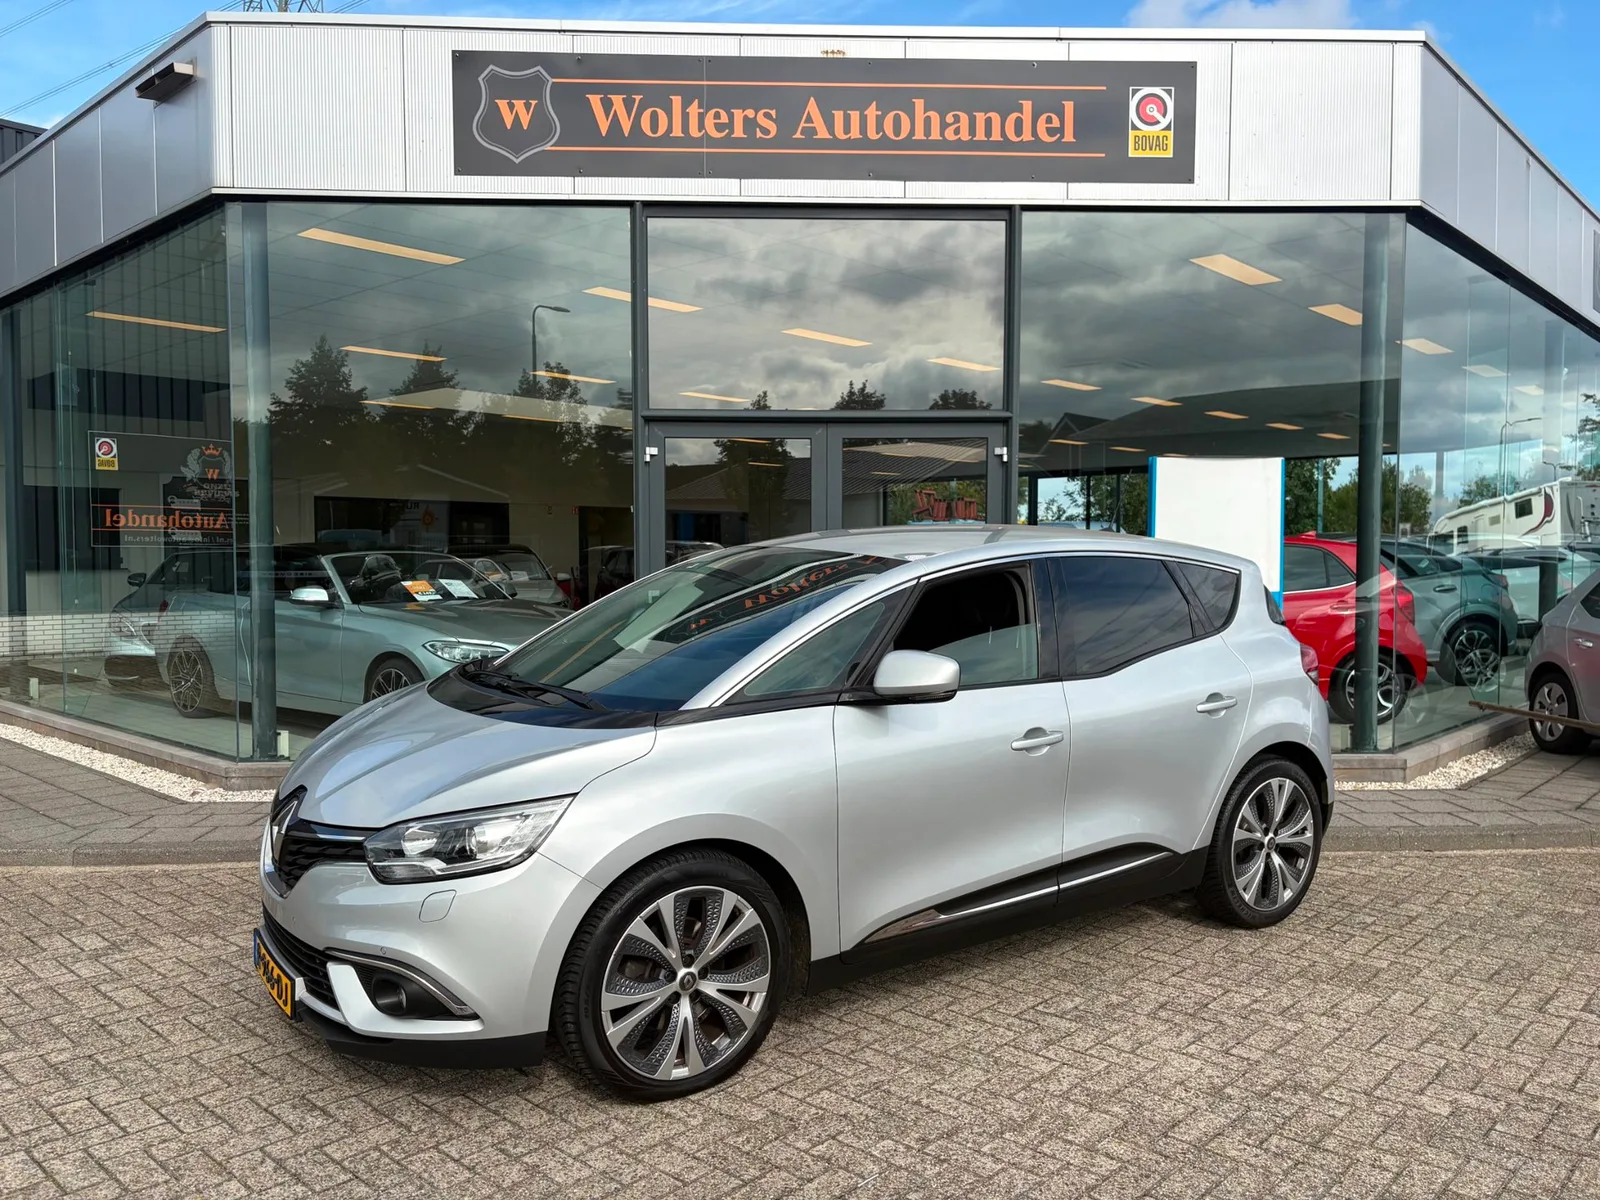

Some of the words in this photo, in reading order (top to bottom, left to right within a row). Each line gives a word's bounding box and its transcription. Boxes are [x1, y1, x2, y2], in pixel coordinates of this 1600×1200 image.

[495, 99, 538, 130] W
[586, 94, 777, 139] Wolters
[792, 96, 1076, 143] Autohandel
[1134, 135, 1168, 151] BOVAG
